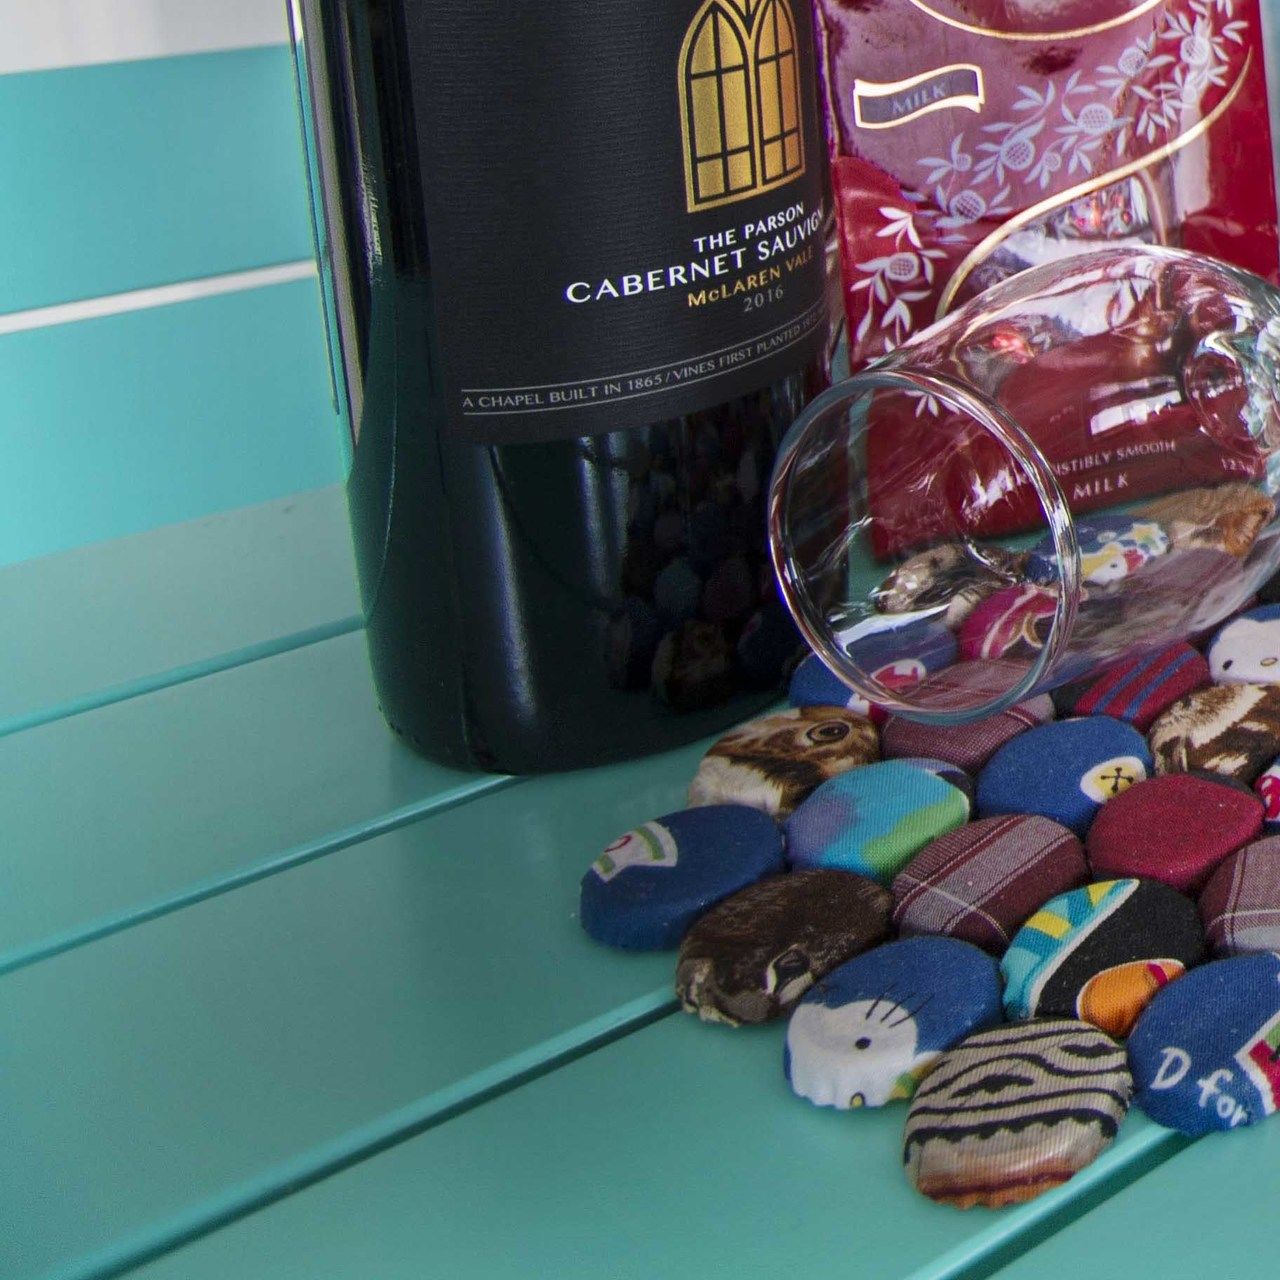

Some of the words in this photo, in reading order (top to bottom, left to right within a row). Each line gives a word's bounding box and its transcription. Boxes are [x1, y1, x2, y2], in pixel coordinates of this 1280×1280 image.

[892, 81, 946, 114] MILK
[693, 228, 737, 254] THE
[743, 202, 804, 240] PARSON
[565, 248, 747, 304] CABERNET
[688, 265, 781, 308] McLAREN
[743, 286, 785, 313] 2016
[462, 397, 474, 409] A
[478, 394, 544, 408] CHAPEL
[549, 386, 598, 403] BUILT
[604, 381, 622, 396] IN
[628, 373, 663, 391] 1865
[673, 359, 716, 381] VINES
[718, 347, 753, 367] FIRST
[756, 324, 801, 355] PLANTED
[1116, 438, 1177, 462] SMOOTH
[1073, 471, 1129, 500] MILK
[1150, 1046, 1192, 1091] D
[1197, 1068, 1248, 1128] for
